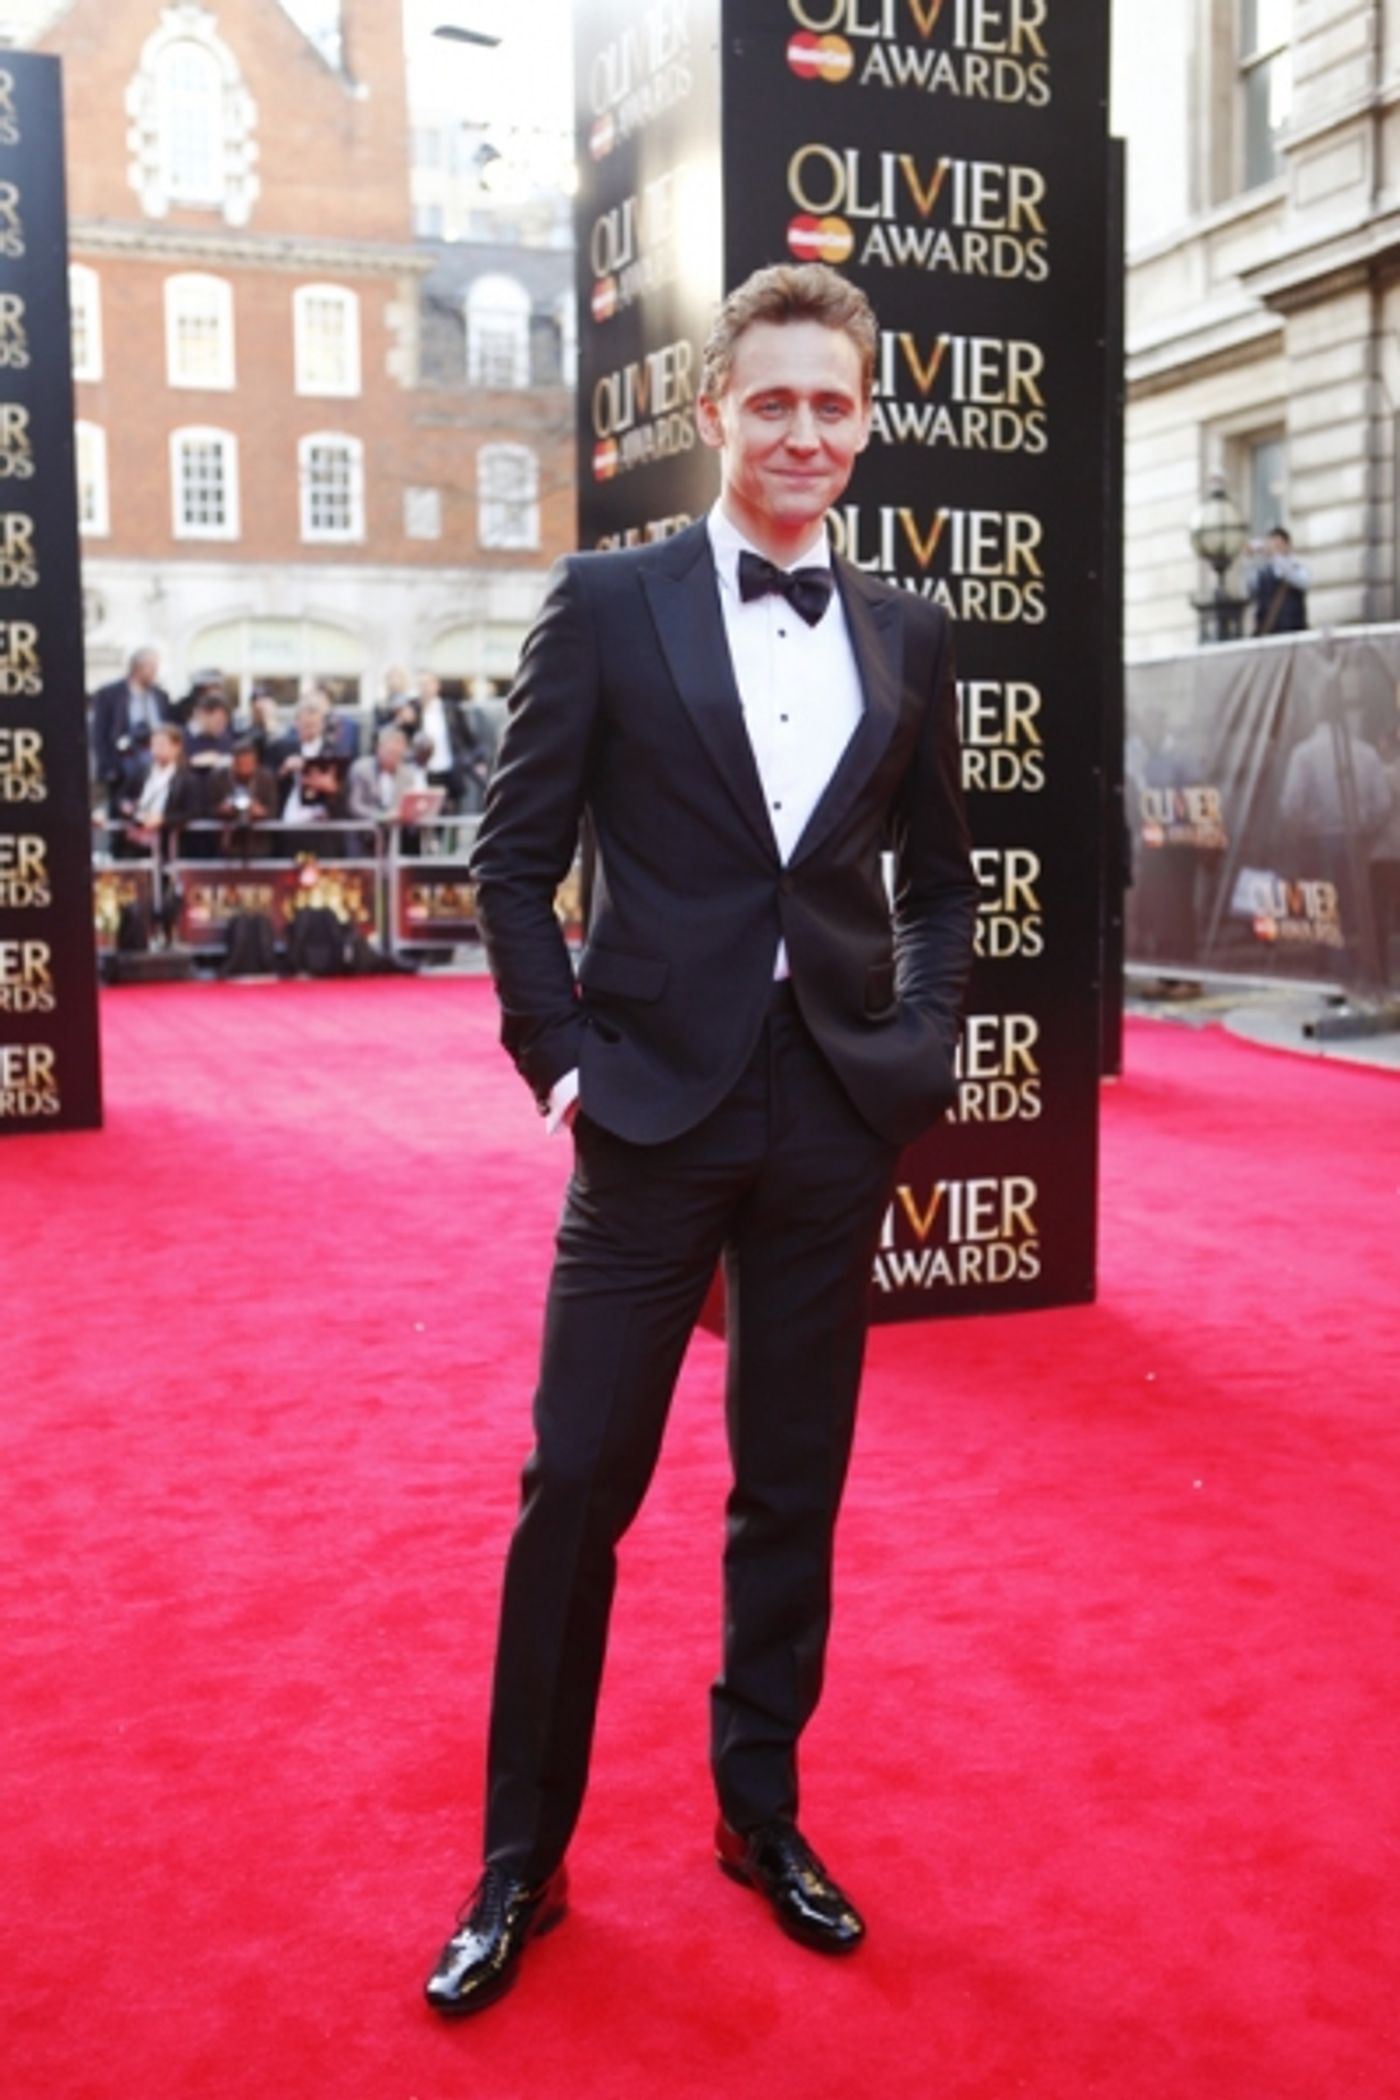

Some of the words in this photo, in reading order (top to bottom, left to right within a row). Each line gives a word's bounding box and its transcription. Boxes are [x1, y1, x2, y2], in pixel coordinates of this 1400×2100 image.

[859, 43, 1051, 107] AWARDS
[787, 143, 1046, 235] OLIVIER
[859, 224, 1049, 282] AWARDS
[592, 339, 694, 438] OLIVIER
[872, 331, 1046, 406] IVIER
[870, 402, 1048, 453] AWARDS
[962, 748, 1046, 792] RDS
[946, 1079, 1042, 1124] RDS
[872, 1240, 1040, 1292] AWARDS
